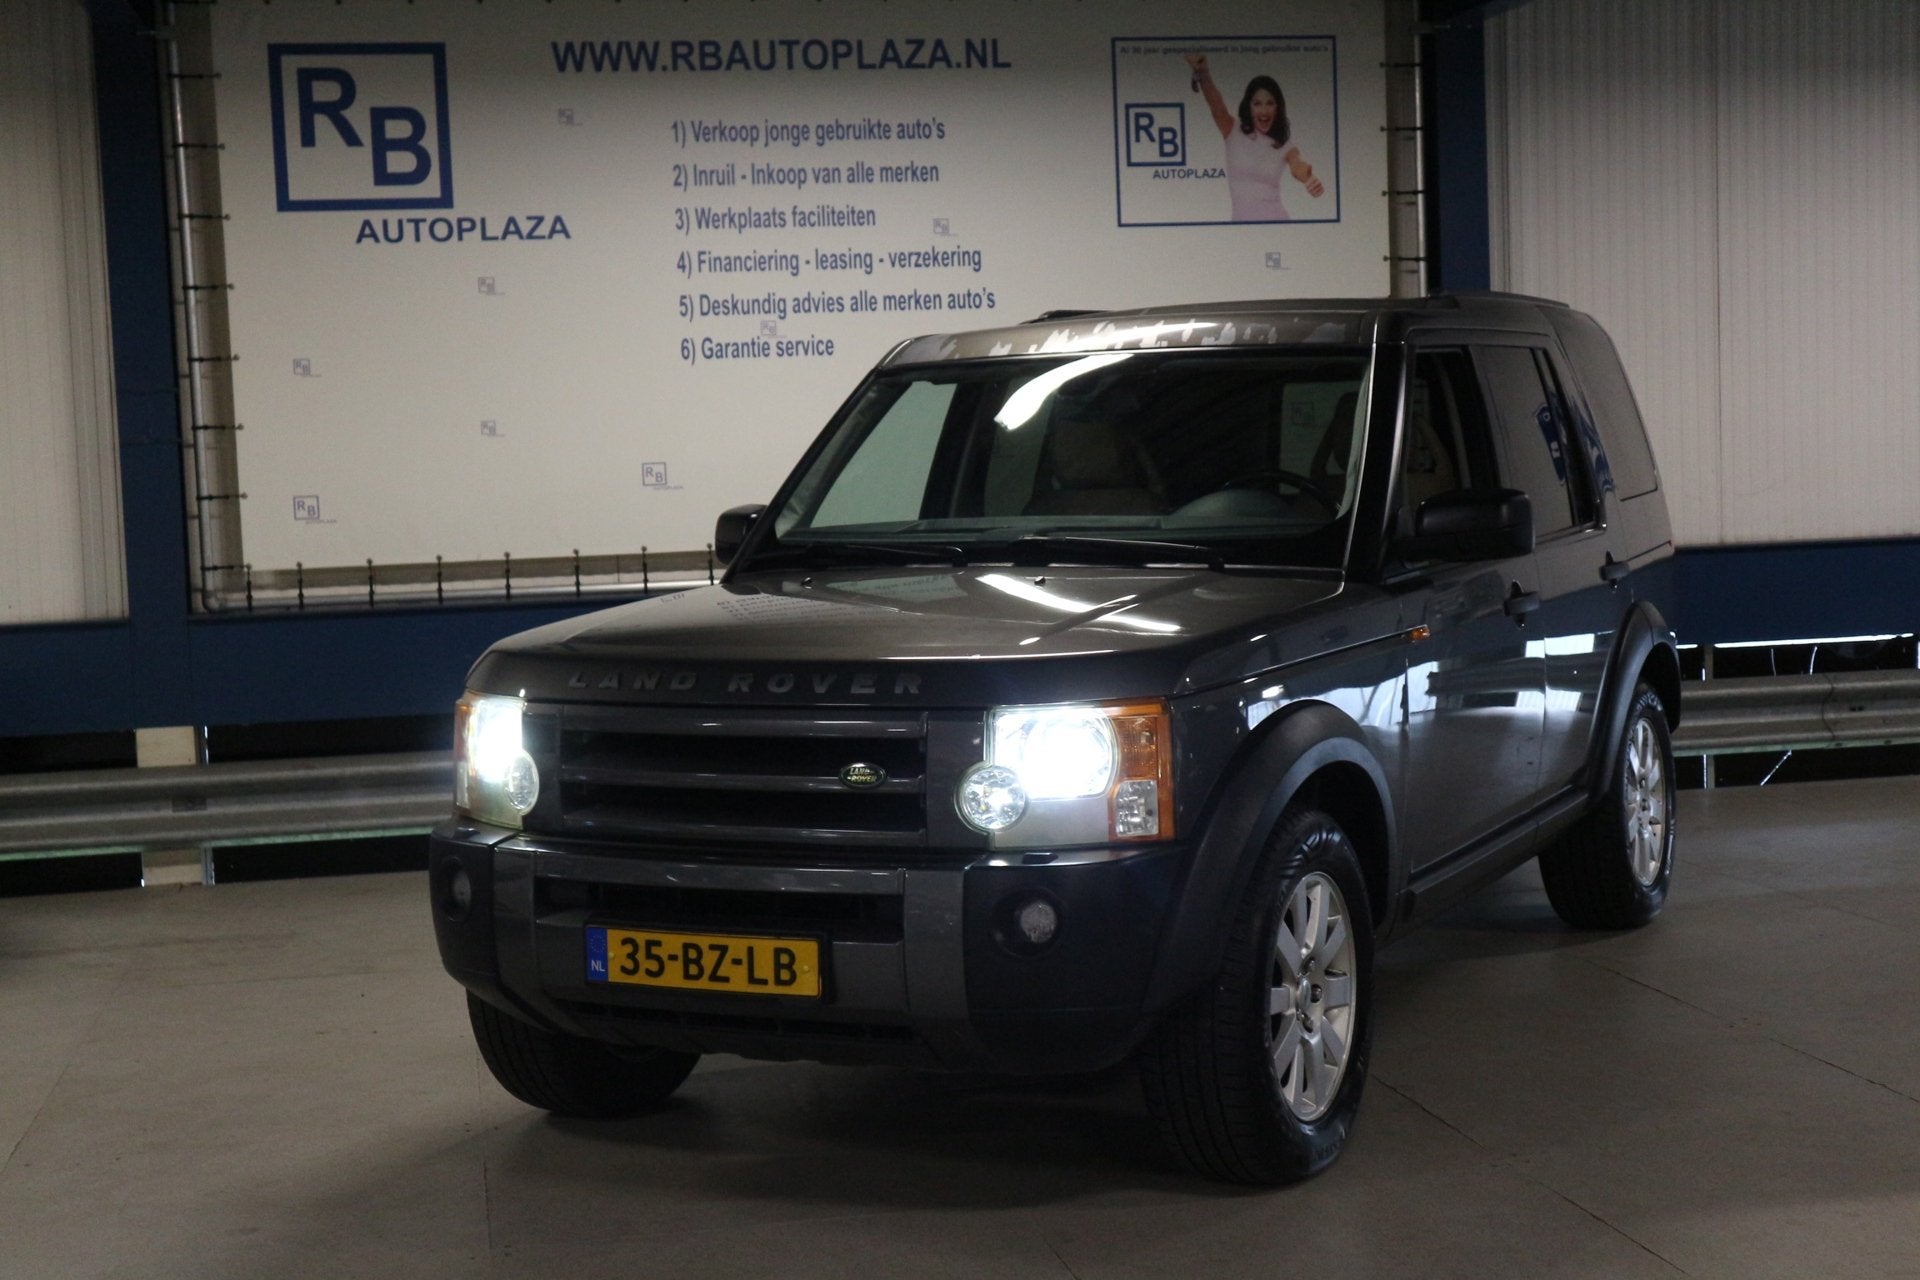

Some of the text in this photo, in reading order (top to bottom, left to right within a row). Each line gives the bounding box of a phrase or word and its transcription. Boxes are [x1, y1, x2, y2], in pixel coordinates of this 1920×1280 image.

[550, 37, 1012, 74] WWW.RBAUTOPLAZA.NL
[297, 67, 432, 187] RB
[671, 116, 946, 148] 1) Verkoop jonge gebruikte auto's
[1134, 112, 1179, 157] RB
[673, 164, 688, 191] 2)
[692, 162, 736, 187] Inruil
[750, 162, 808, 190] Inkoop
[811, 166, 842, 185] van
[846, 160, 875, 184] alle
[879, 160, 940, 183] merken
[1153, 168, 1227, 179] AUTOPLAZA
[355, 215, 571, 245] AUTOPLAZA
[675, 204, 876, 235] 3) Werkplaats faciliteiten
[677, 252, 692, 278] 4)
[697, 249, 800, 278] Financiering
[814, 247, 874, 276] leasing
[888, 244, 982, 273] verzekering
[680, 287, 996, 322] 5) Deskundig advies alle merken auto's
[681, 334, 835, 365] 6) Garantie service
[568, 671, 923, 695] LAND ROVER
[591, 959, 605, 972] NL
[620, 937, 797, 986] 35-BZ-LB
